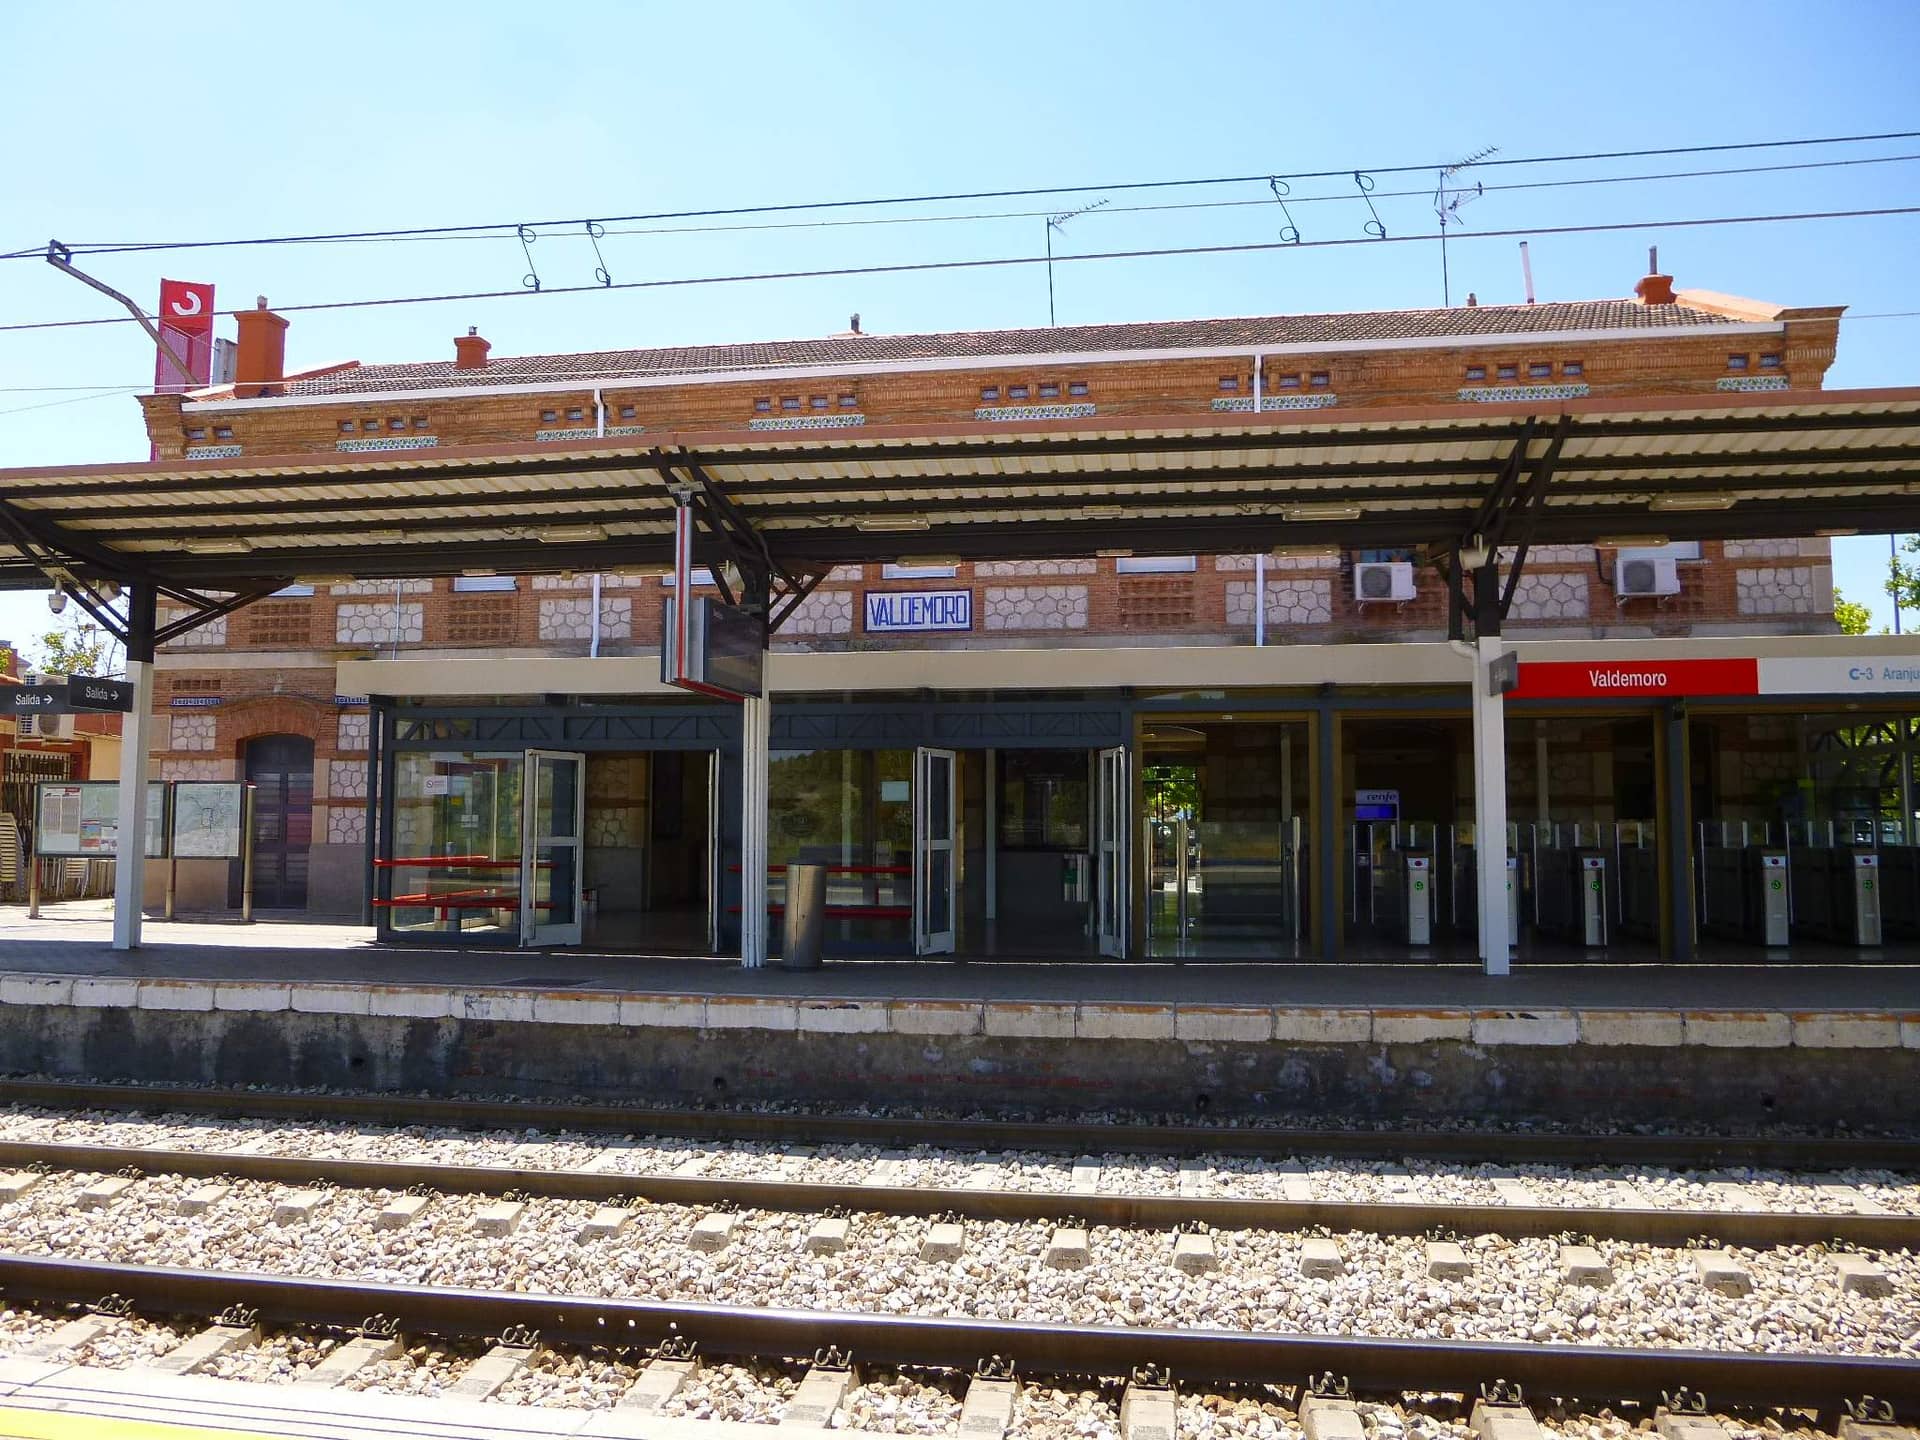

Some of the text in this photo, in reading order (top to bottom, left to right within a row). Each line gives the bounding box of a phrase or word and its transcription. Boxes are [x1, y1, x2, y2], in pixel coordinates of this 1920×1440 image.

[870, 595, 968, 626] VALDEMORO
[1588, 669, 1667, 687] Valdemoro
[1849, 666, 1874, 681] C-3
[15, 694, 40, 705] Salida
[85, 686, 108, 700] Salida
[1366, 791, 1397, 803] renfe
